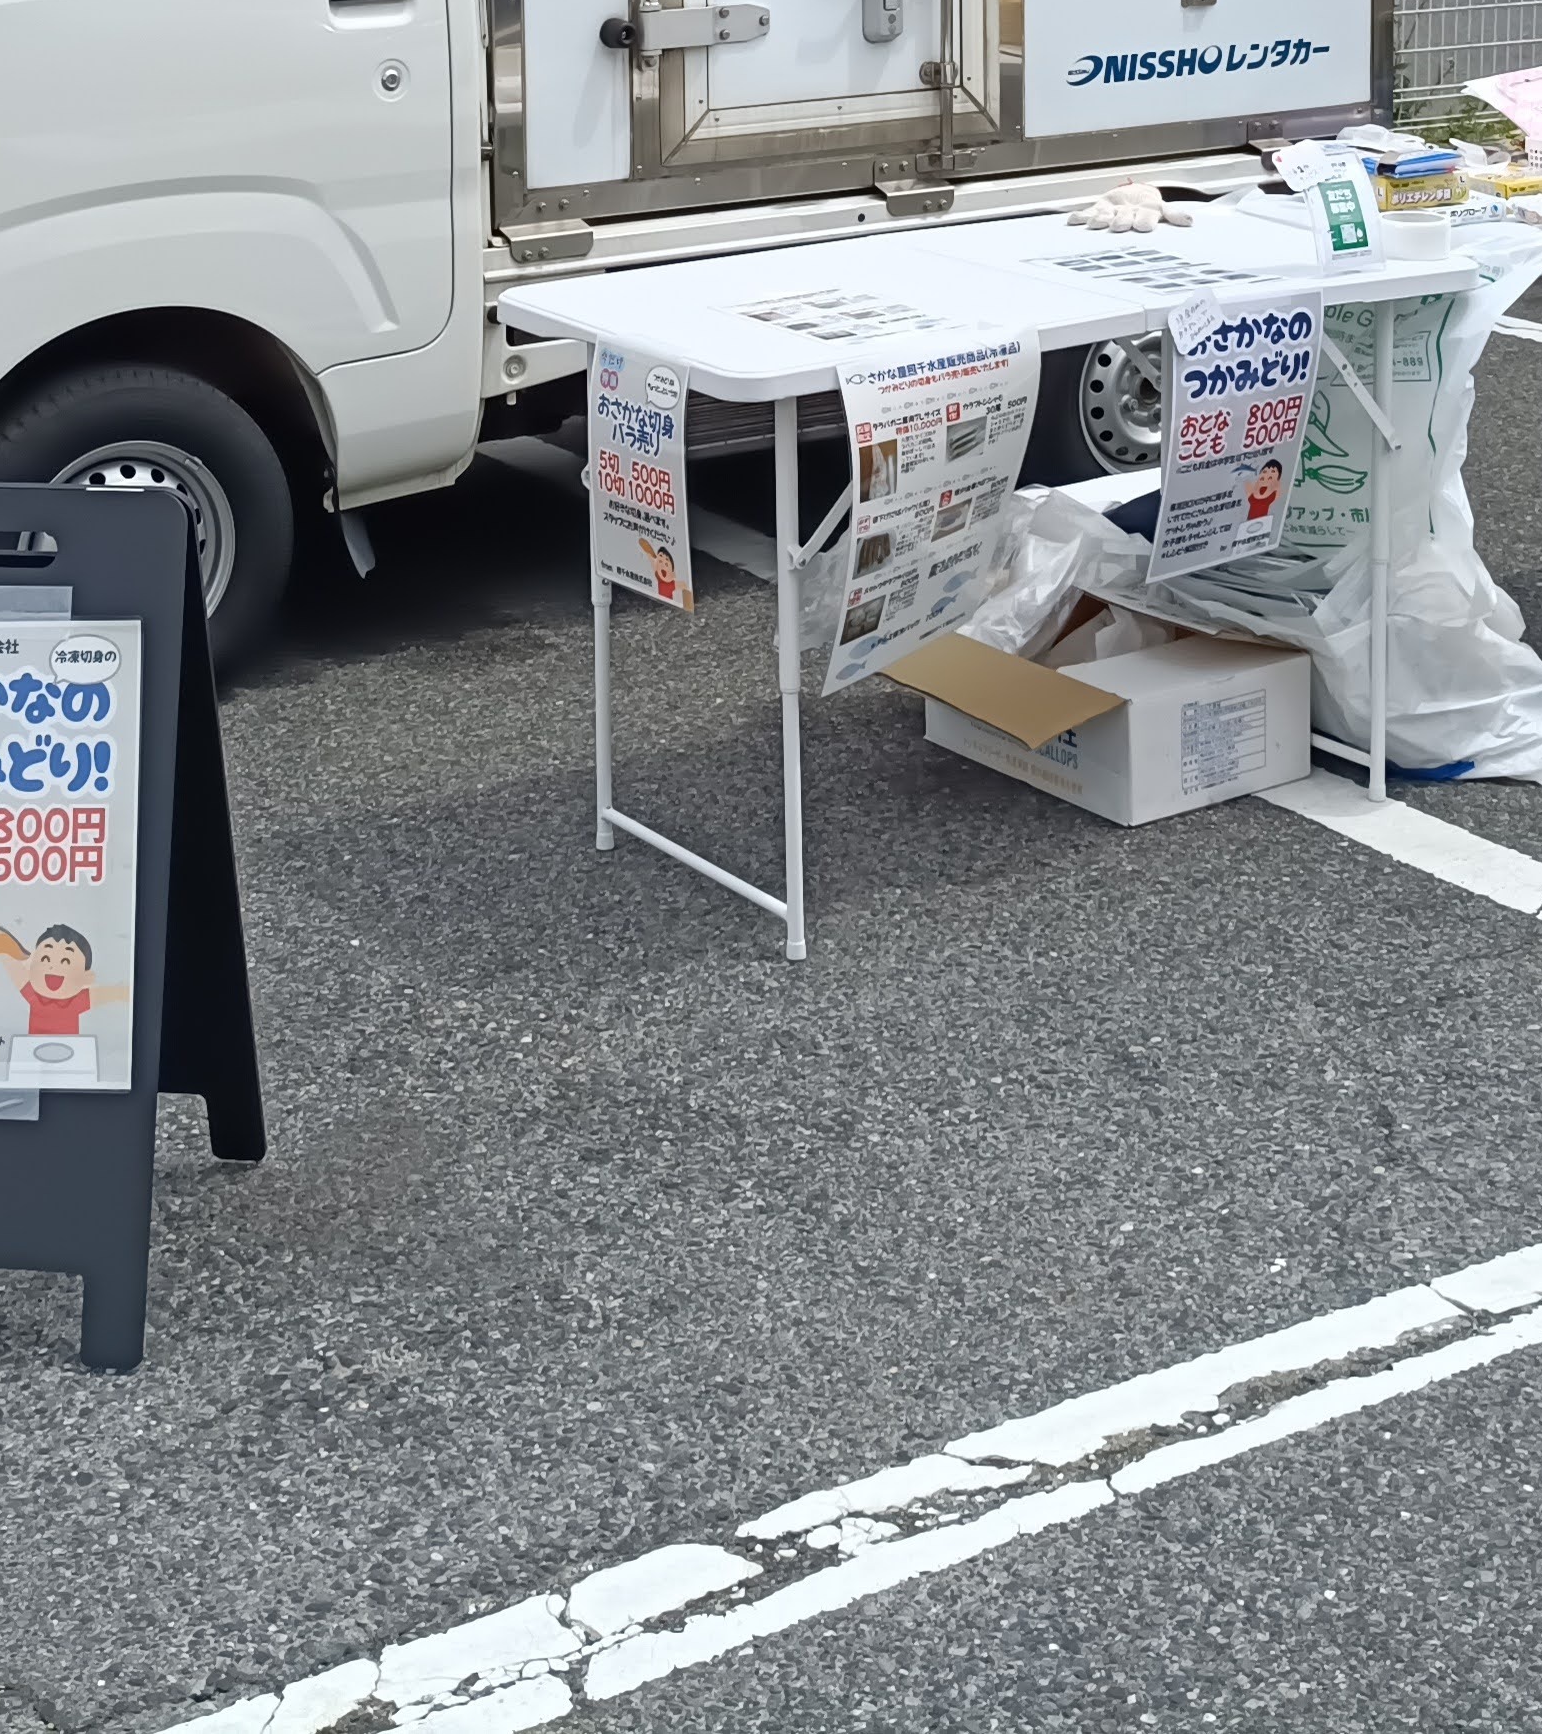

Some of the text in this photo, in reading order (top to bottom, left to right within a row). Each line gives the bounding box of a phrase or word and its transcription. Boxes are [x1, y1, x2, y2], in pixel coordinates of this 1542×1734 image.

[1103, 38, 1330, 84] NISSHO レンタカー
[1184, 350, 1310, 399] つかみどり!
[598, 393, 675, 440] おさかな切身
[1180, 395, 1303, 438] おとな 800円
[612, 422, 660, 458] バラ売り
[1178, 418, 1298, 461] こども 500円
[598, 470, 675, 515] 10切 1000円
[600, 450, 670, 492] 5切 500円
[54, 650, 117, 664] 冷凍切身の
